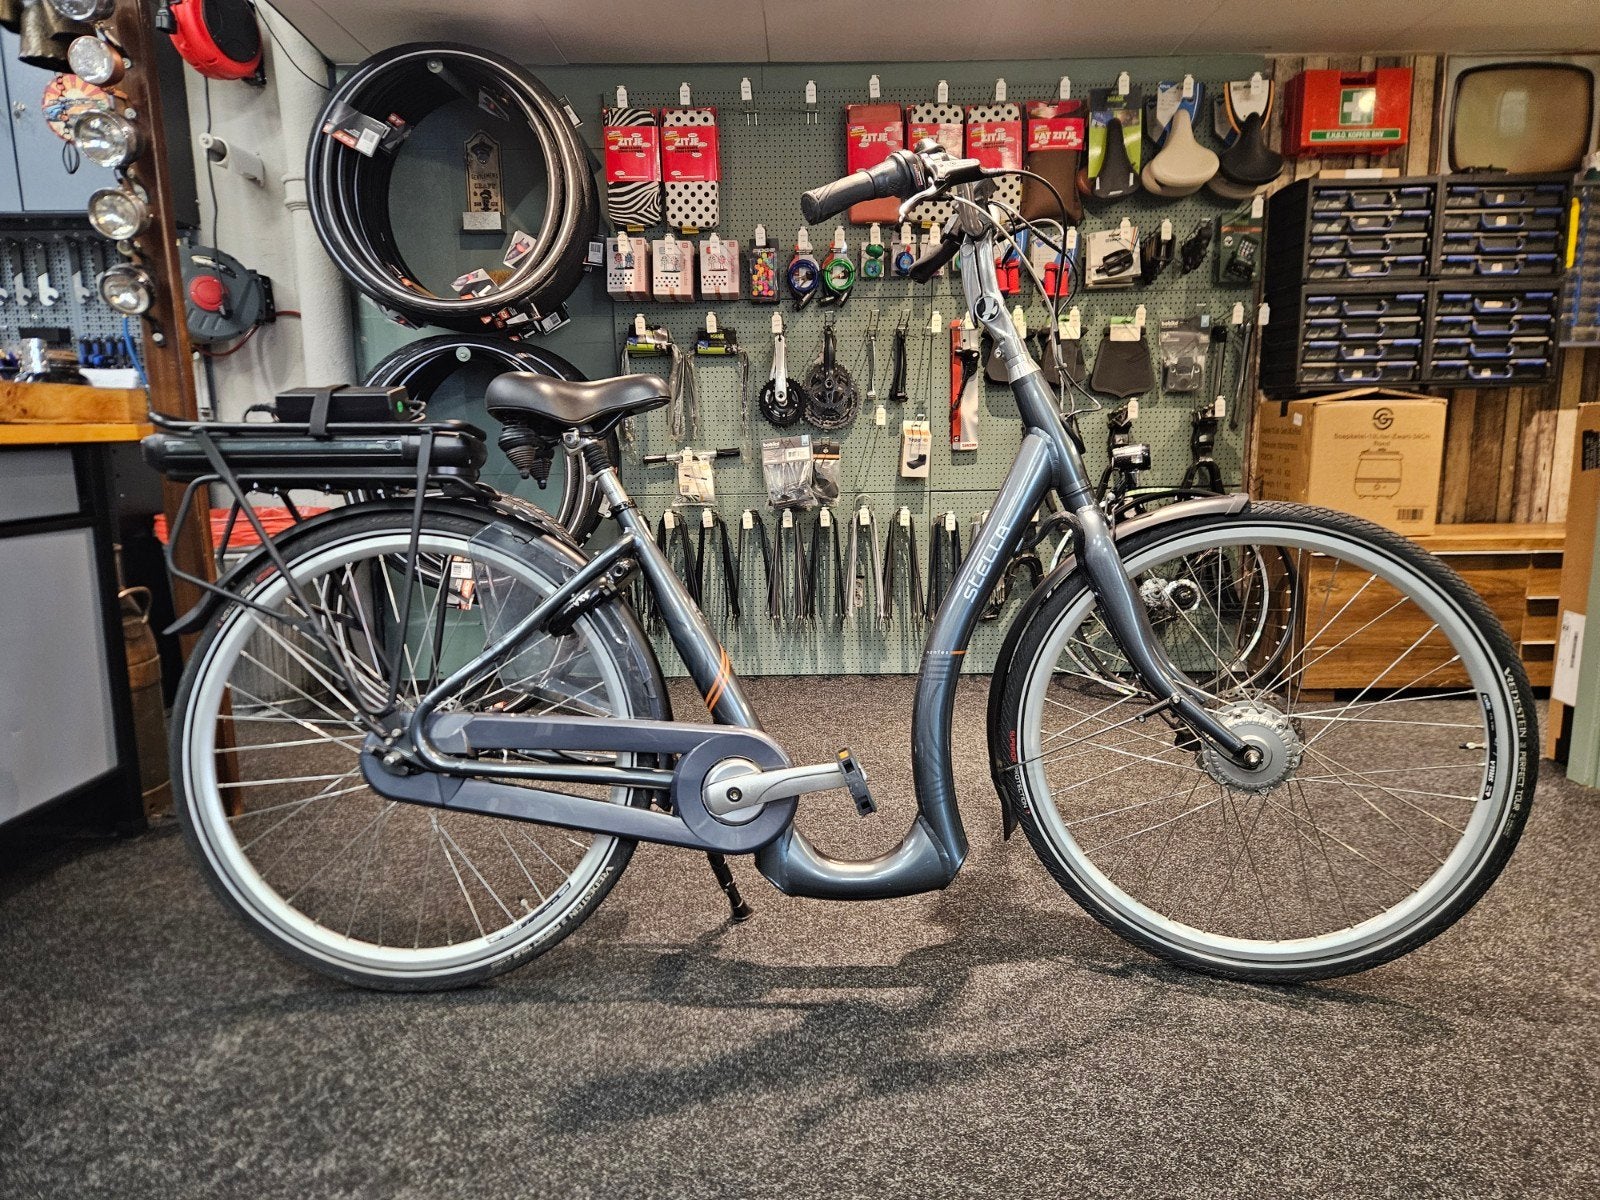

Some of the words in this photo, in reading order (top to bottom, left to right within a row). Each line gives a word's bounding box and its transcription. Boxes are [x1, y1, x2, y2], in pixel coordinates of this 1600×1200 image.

[617, 137, 644, 147] ZITJE
[674, 137, 700, 147] ZITJE
[861, 132, 888, 143] ZITJE
[963, 525, 1011, 604] STELLA
[1503, 666, 1528, 738] VREDESTEIN
[1009, 730, 1017, 763] SUPERIOR
[1014, 767, 1029, 809] PROTECTION
[1517, 750, 1527, 788] PERFECT
[1511, 789, 1525, 812] TOUR
[568, 865, 615, 918] VREDESTEIN
